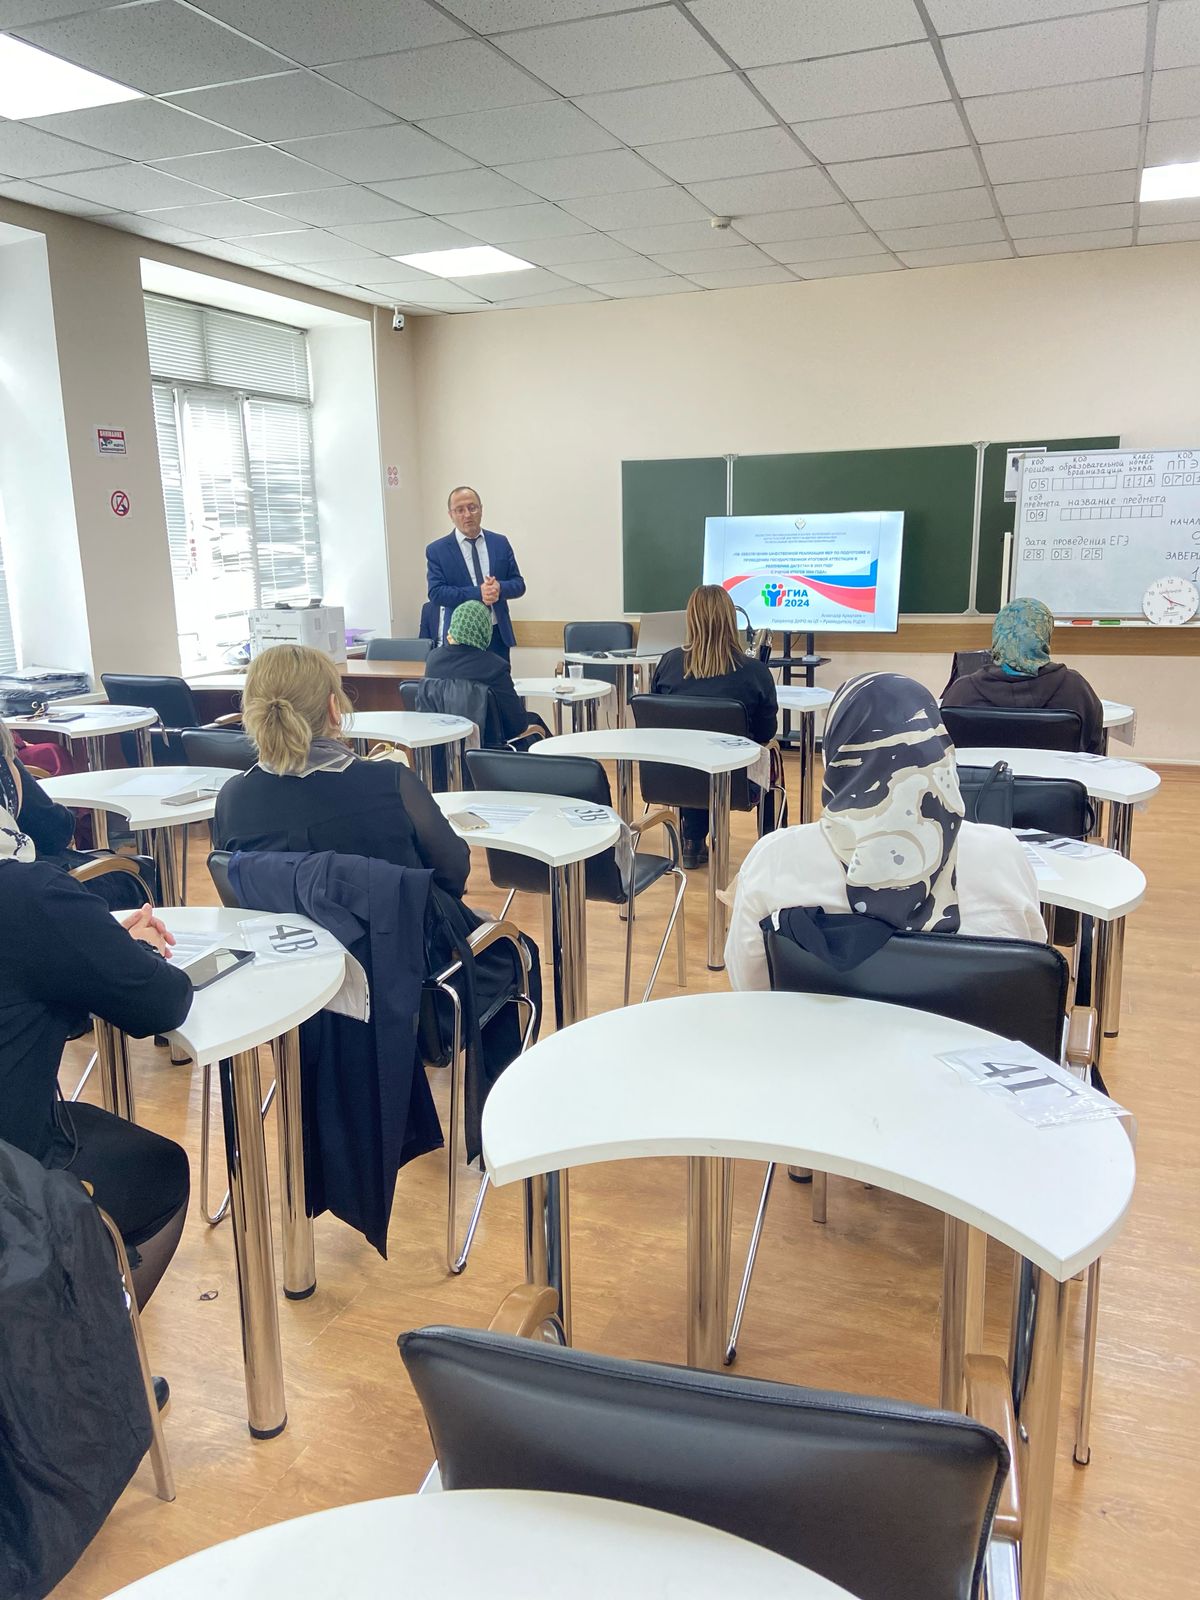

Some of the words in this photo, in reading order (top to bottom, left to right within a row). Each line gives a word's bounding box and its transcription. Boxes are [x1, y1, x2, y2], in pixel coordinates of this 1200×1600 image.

[1167, 459, 1198, 471] ППЭ
[1030, 480, 1046, 490] 05
[1068, 498, 1116, 506] название
[1123, 494, 1166, 505] предмета
[1029, 511, 1044, 519] 09
[1109, 535, 1129, 547] ЕГЭ
[1053, 550, 1070, 559] 03
[1084, 549, 1101, 558] 25
[787, 589, 808, 598] ГИА
[784, 599, 810, 607] 2024
[982, 1061, 1080, 1098] 4Г
